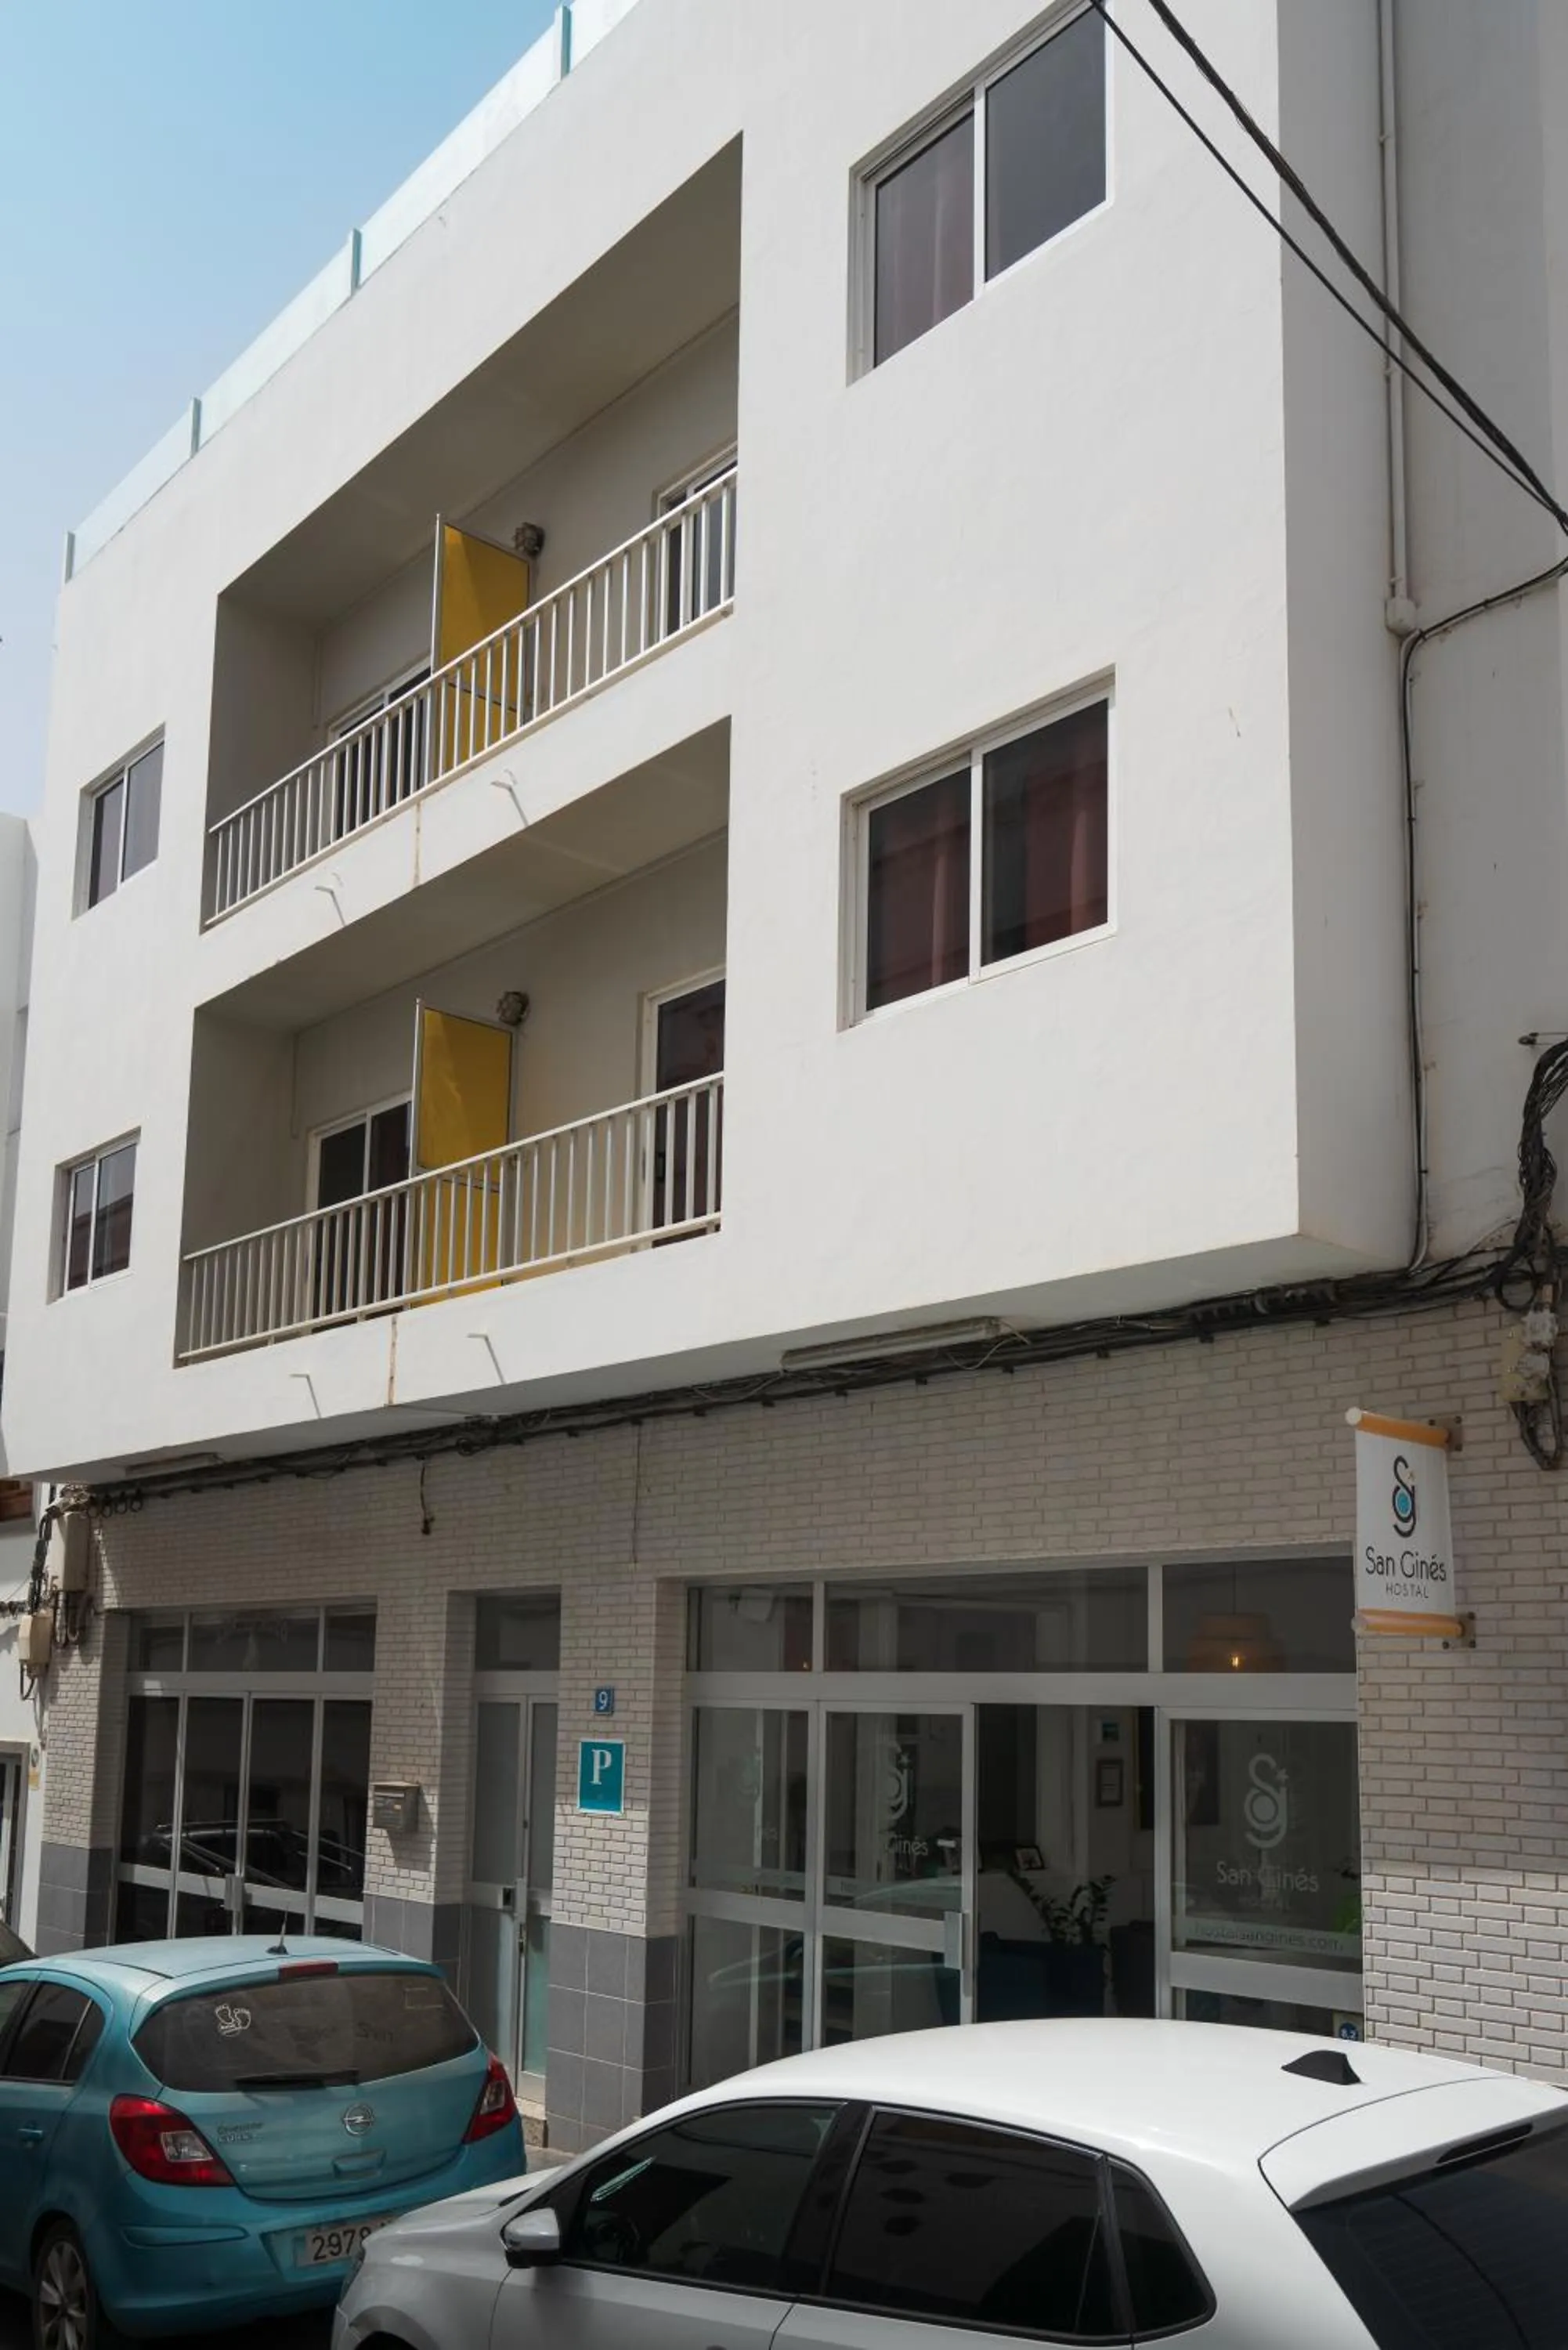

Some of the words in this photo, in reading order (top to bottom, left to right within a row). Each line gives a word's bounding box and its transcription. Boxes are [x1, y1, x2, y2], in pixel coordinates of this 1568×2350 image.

[1365, 1546, 1396, 1576] San
[1400, 1550, 1447, 1582] Ginés
[1386, 1582, 1429, 1599] HOSTAL
[599, 1691, 609, 1711] 9
[589, 1748, 612, 1785] P
[1216, 1860, 1252, 1886] San
[1258, 1865, 1320, 1893] Ginés
